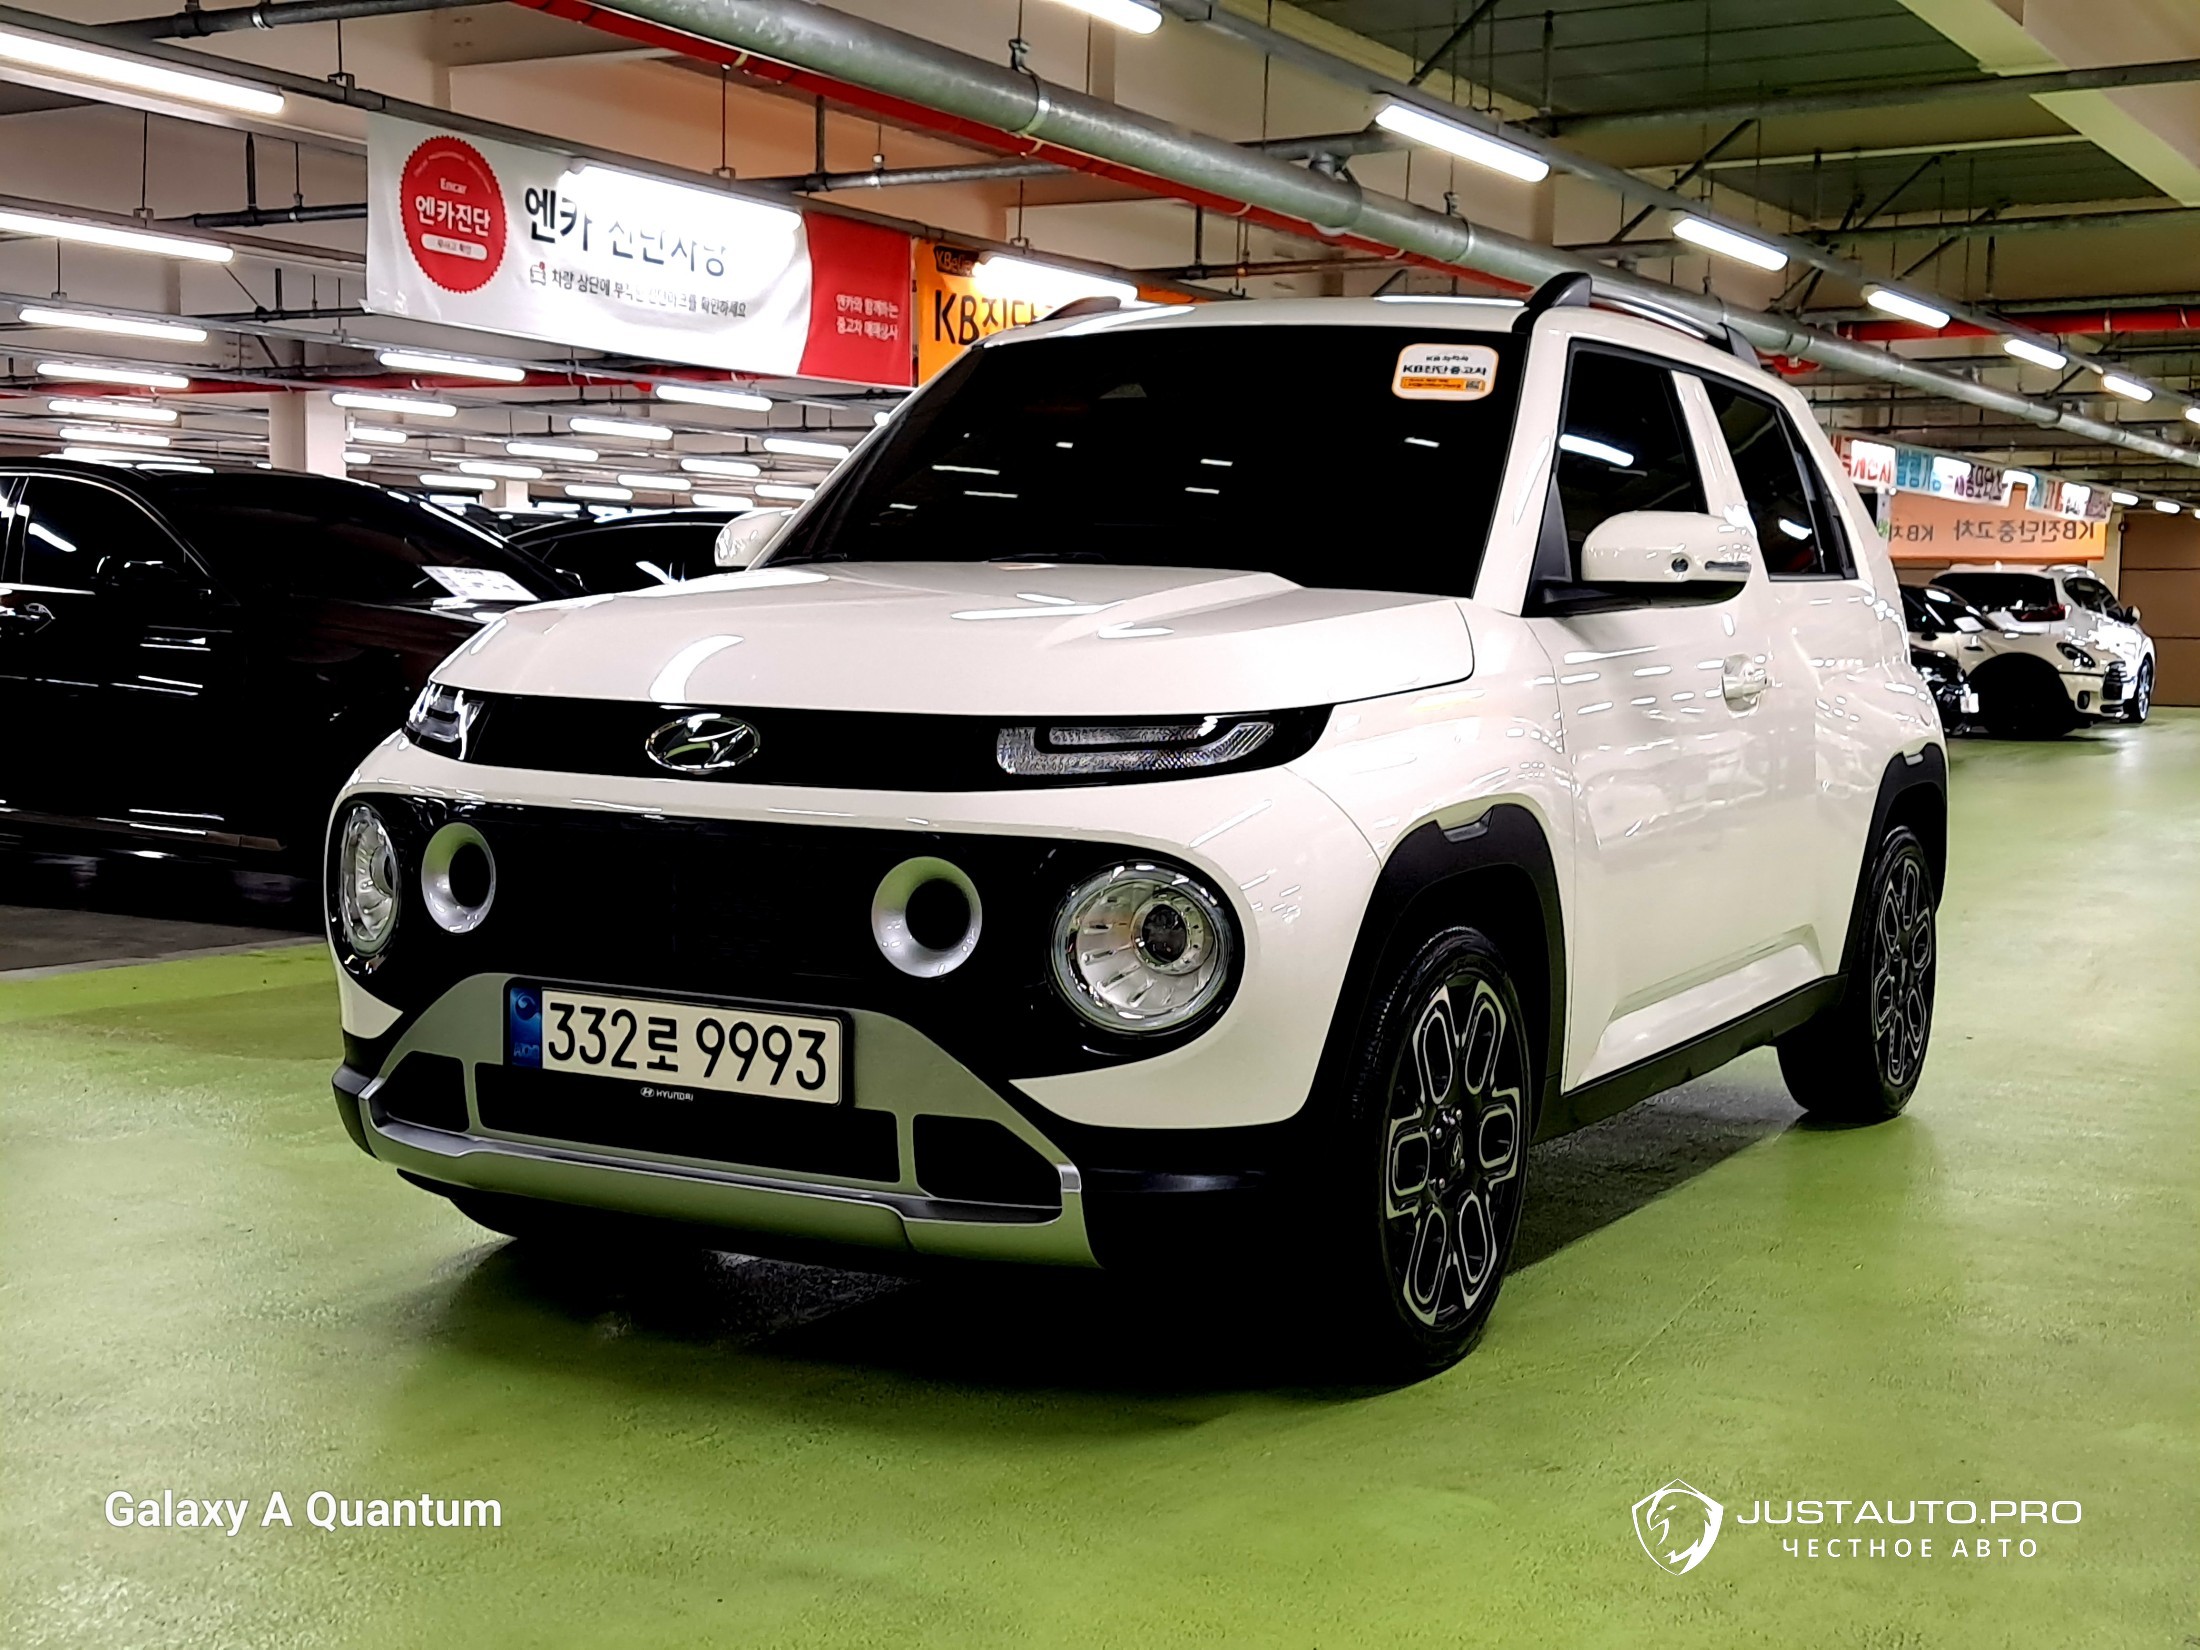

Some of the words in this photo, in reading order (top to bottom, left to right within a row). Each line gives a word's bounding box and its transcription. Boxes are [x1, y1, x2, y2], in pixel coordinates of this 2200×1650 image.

[415, 195, 491, 237] 엔카진단
[525, 188, 592, 251] 엔카
[552, 269, 574, 290] 차량
[577, 274, 610, 297] 상단에
[547, 1001, 679, 1073] 332로
[695, 1017, 827, 1091] 9993
